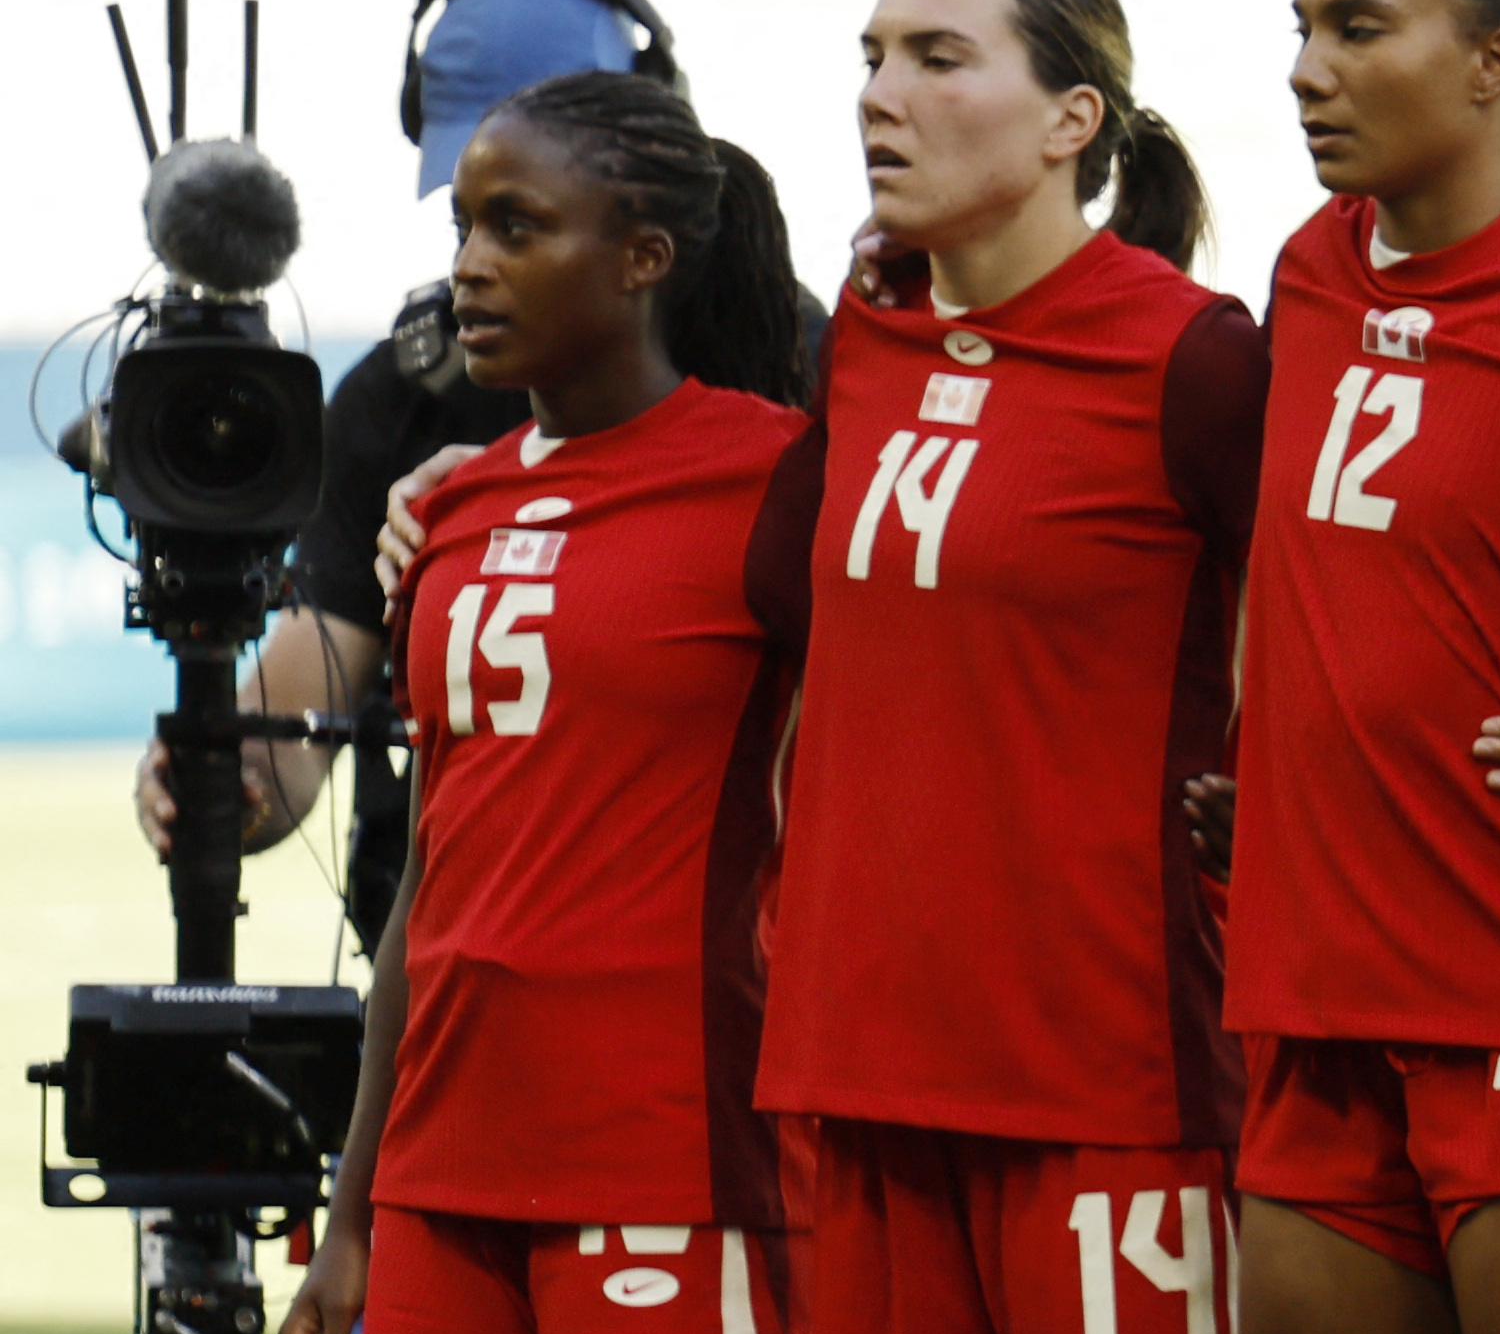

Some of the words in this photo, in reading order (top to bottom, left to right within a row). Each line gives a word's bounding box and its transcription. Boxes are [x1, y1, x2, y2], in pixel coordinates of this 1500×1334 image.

[846, 430, 979, 589] 14
[1307, 366, 1423, 531] 12
[446, 583, 554, 737] 15
